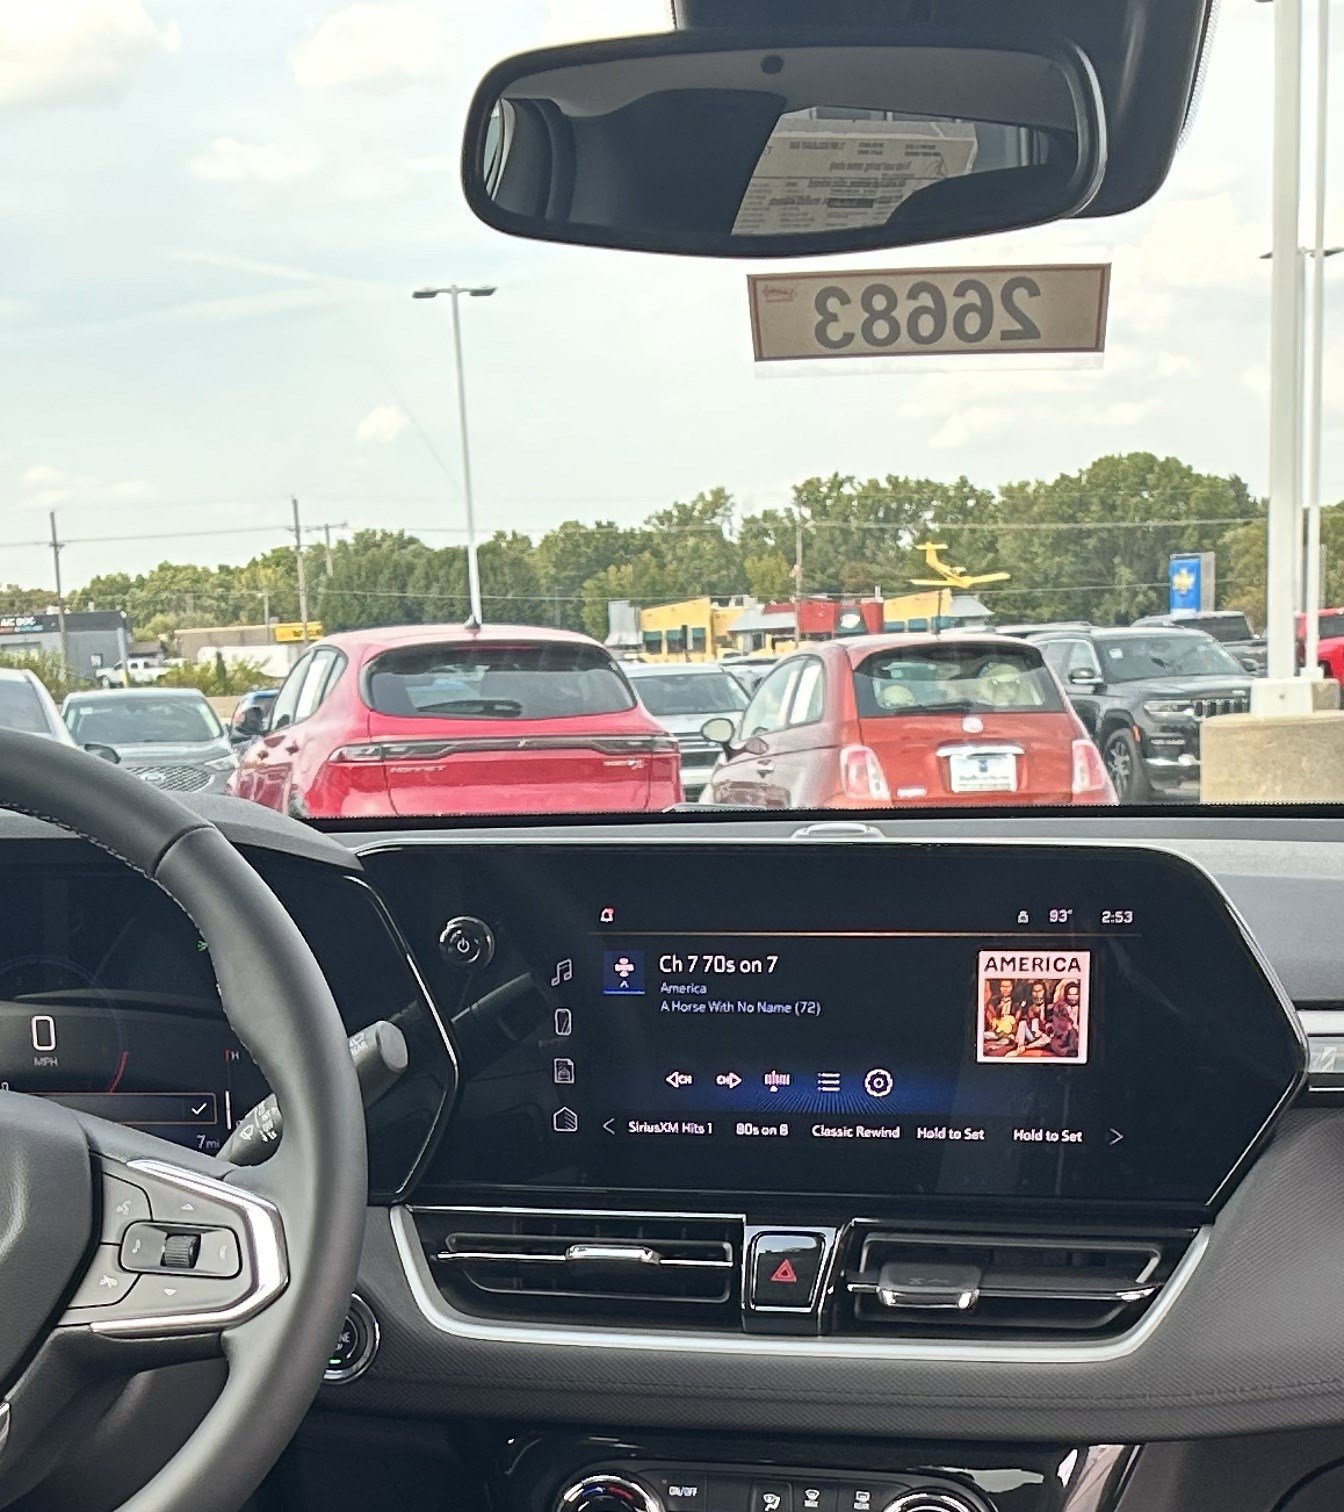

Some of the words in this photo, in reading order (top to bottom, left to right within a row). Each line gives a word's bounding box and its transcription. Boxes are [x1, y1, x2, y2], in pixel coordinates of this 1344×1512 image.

[1102, 911, 1133, 923] 2:53
[659, 955, 683, 973] Ch
[687, 955, 698, 973] 7
[703, 955, 736, 973] 70s
[739, 960, 762, 973] on
[767, 955, 778, 973] 7
[984, 957, 1081, 972] AMERICA
[660, 982, 707, 994] America
[660, 1001, 670, 1012] A
[672, 1001, 706, 1013] Horse
[708, 1001, 734, 1013] With
[737, 1001, 754, 1013] No
[757, 1001, 792, 1014] Name
[794, 1001, 821, 1017] (72)
[31, 1015, 56, 1051] 0
[34, 1056, 58, 1067] MPH
[628, 1120, 678, 1134] SiriusXM
[682, 1121, 705, 1134] Hits
[736, 1123, 759, 1136] 80s
[761, 1126, 777, 1136] on
[812, 1124, 853, 1138] Classic
[856, 1126, 900, 1139] Rewind
[917, 1127, 946, 1140] Hold
[948, 1128, 961, 1140] to
[964, 1127, 985, 1140] Set
[197, 1134, 205, 1149] 7
[1013, 1129, 1043, 1142] Hold
[1045, 1130, 1058, 1142] to
[1061, 1130, 1083, 1143] Set
[669, 1486, 697, 1497] ON/OFF
